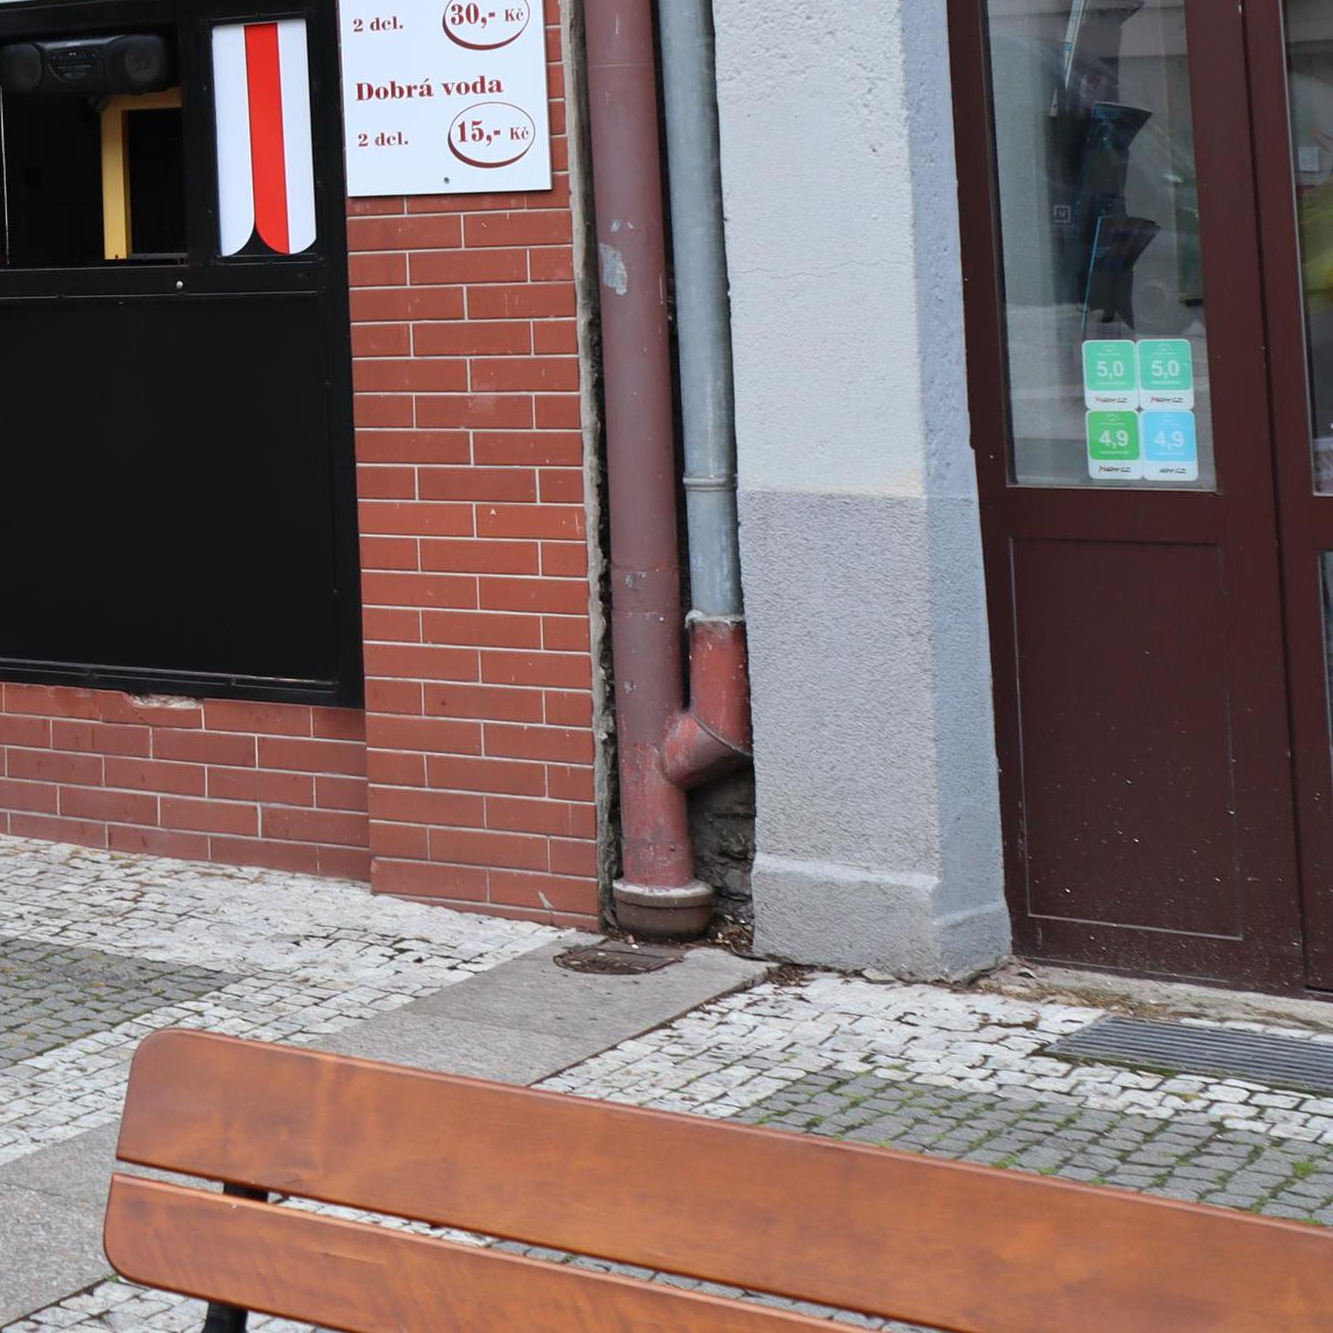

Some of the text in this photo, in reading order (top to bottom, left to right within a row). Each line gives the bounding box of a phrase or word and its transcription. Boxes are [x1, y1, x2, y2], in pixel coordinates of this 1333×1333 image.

[353, 19, 364, 33] 2
[370, 16, 404, 31] dcl.
[504, 8, 524, 22] Kč
[356, 75, 504, 101] Dobrá voda
[357, 133, 369, 147] 2
[375, 132, 409, 147] dcl.
[509, 126, 529, 141] Kč
[1096, 361, 1124, 379] 5,0
[1151, 359, 1180, 379] 5,0
[1099, 430, 1129, 449] 4,9
[1155, 430, 1184, 450] 4,9
